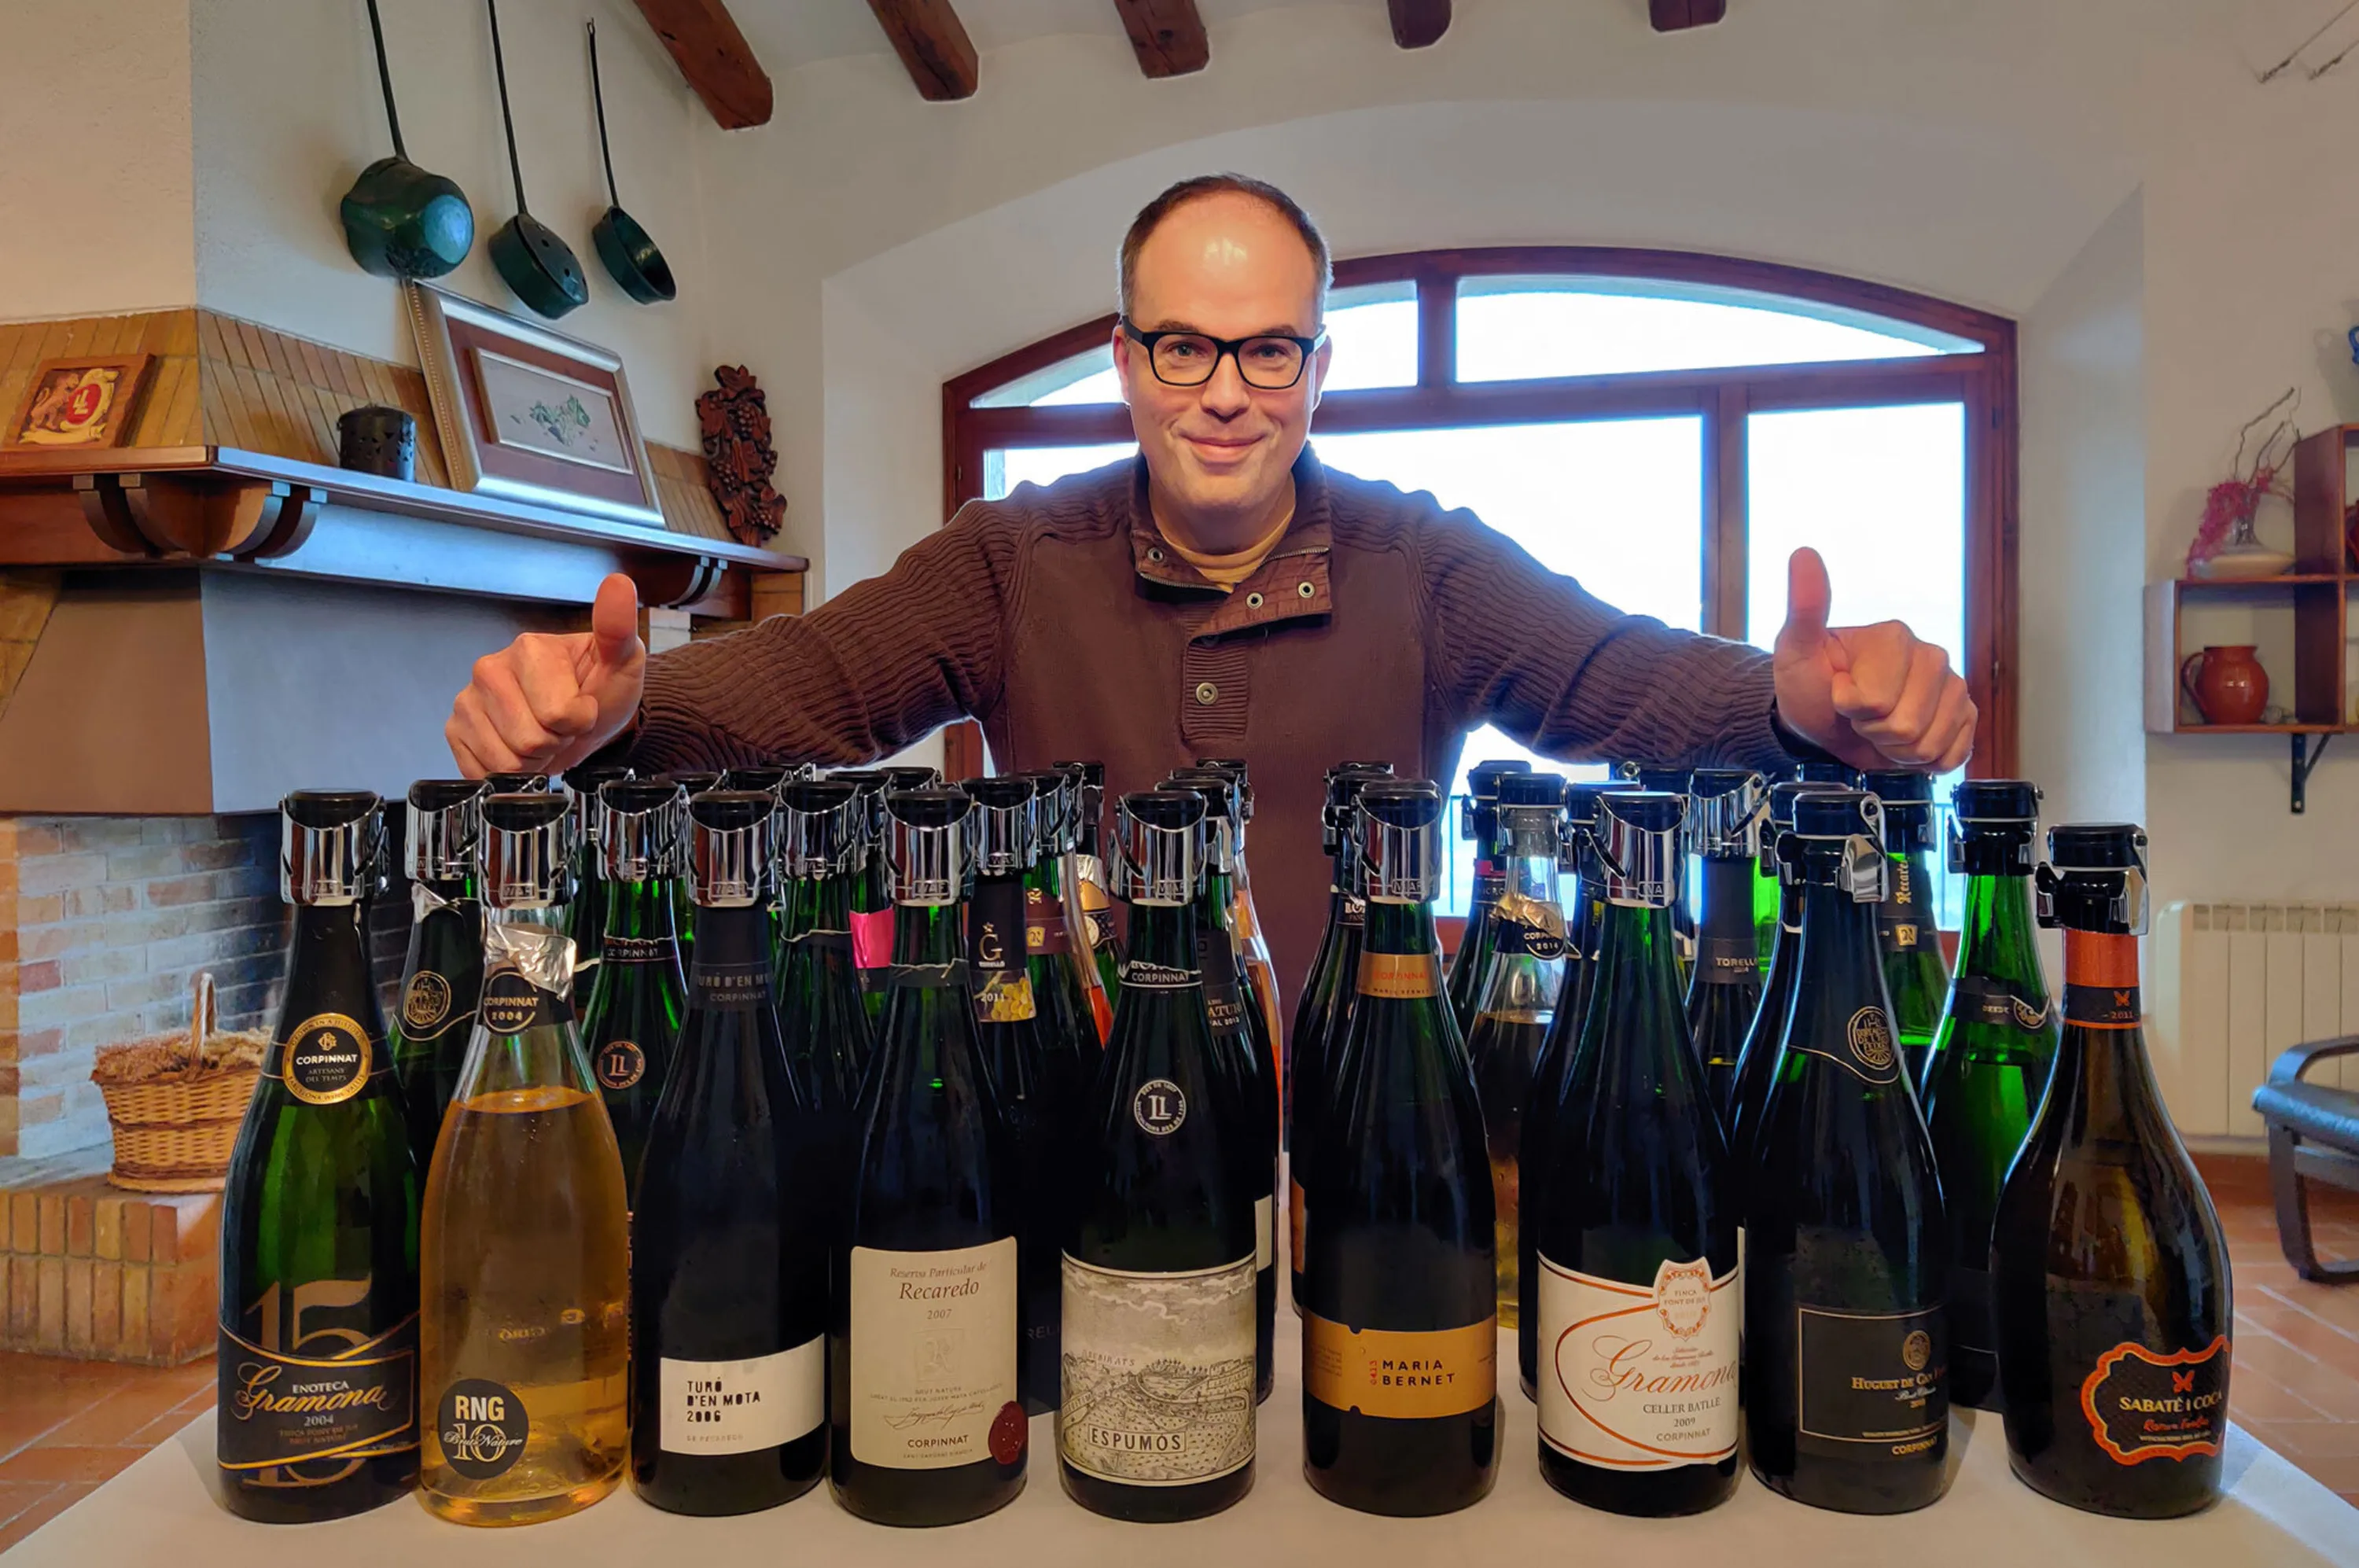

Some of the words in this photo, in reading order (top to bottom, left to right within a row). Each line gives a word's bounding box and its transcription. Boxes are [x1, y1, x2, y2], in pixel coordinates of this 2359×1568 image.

[1132, 972, 1190, 983] CORPINNAT
[484, 996, 539, 1007] CORPINNAT
[491, 1011, 523, 1021] 2004
[296, 1054, 358, 1066] CORPINNAT
[899, 1277, 981, 1300] Recaredo
[927, 1309, 952, 1320] 2007
[1382, 1360, 1443, 1371] MARIA
[1580, 1334, 1739, 1402] Gramona
[686, 1376, 723, 1393] TURÓ
[1382, 1373, 1456, 1386] BERNET
[229, 1361, 398, 1421] Gramona
[292, 1380, 349, 1394] ENOTECA
[686, 1394, 717, 1407] D'EN
[723, 1390, 761, 1407] MOTA
[1643, 1402, 1686, 1415] CELLER
[1687, 1396, 1721, 1413] BATLLE
[455, 1394, 505, 1422] RNG
[304, 1414, 333, 1428] 2004
[686, 1410, 721, 1423] 2006
[1673, 1416, 1696, 1427] 2009
[907, 1434, 970, 1448] CORPINNAT
[1091, 1428, 1181, 1452] ESPUMÓS
[1655, 1427, 1711, 1442] CORPINNAT
[452, 1423, 507, 1463] 10
